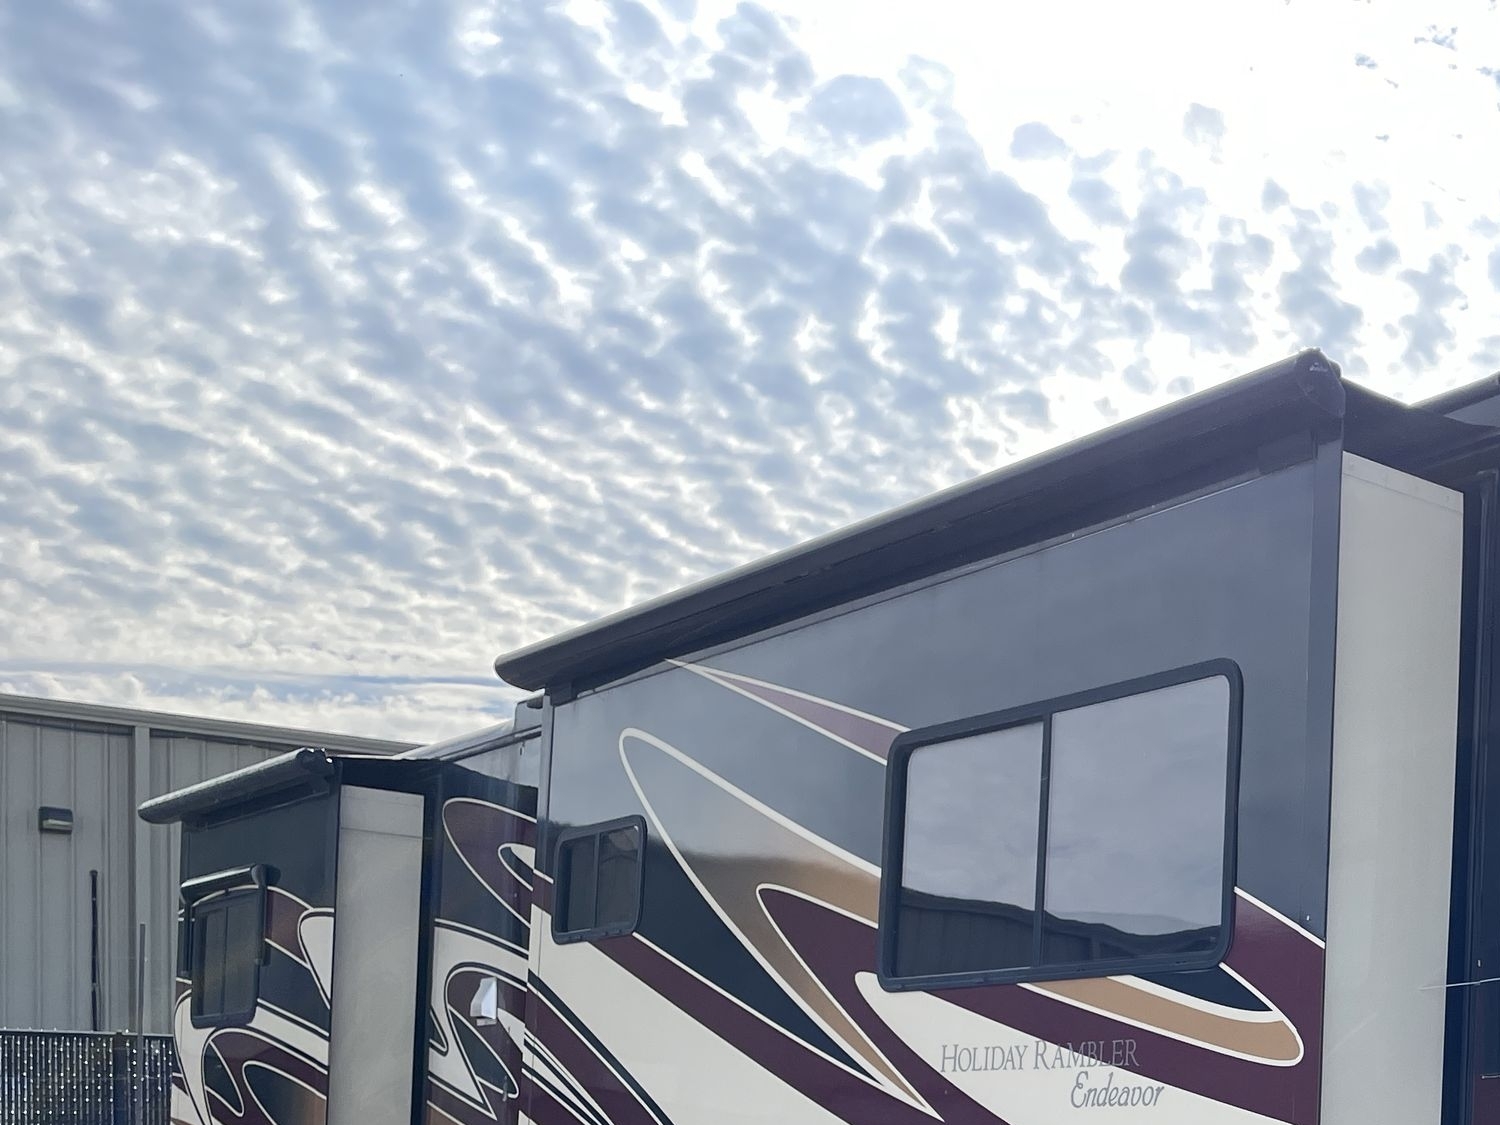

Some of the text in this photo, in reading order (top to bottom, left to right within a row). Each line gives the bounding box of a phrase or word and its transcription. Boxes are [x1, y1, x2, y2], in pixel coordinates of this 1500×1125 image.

[940, 1039, 1140, 1072] HOLIDAY RAMBLER
[1071, 1070, 1165, 1109] Endeavor
